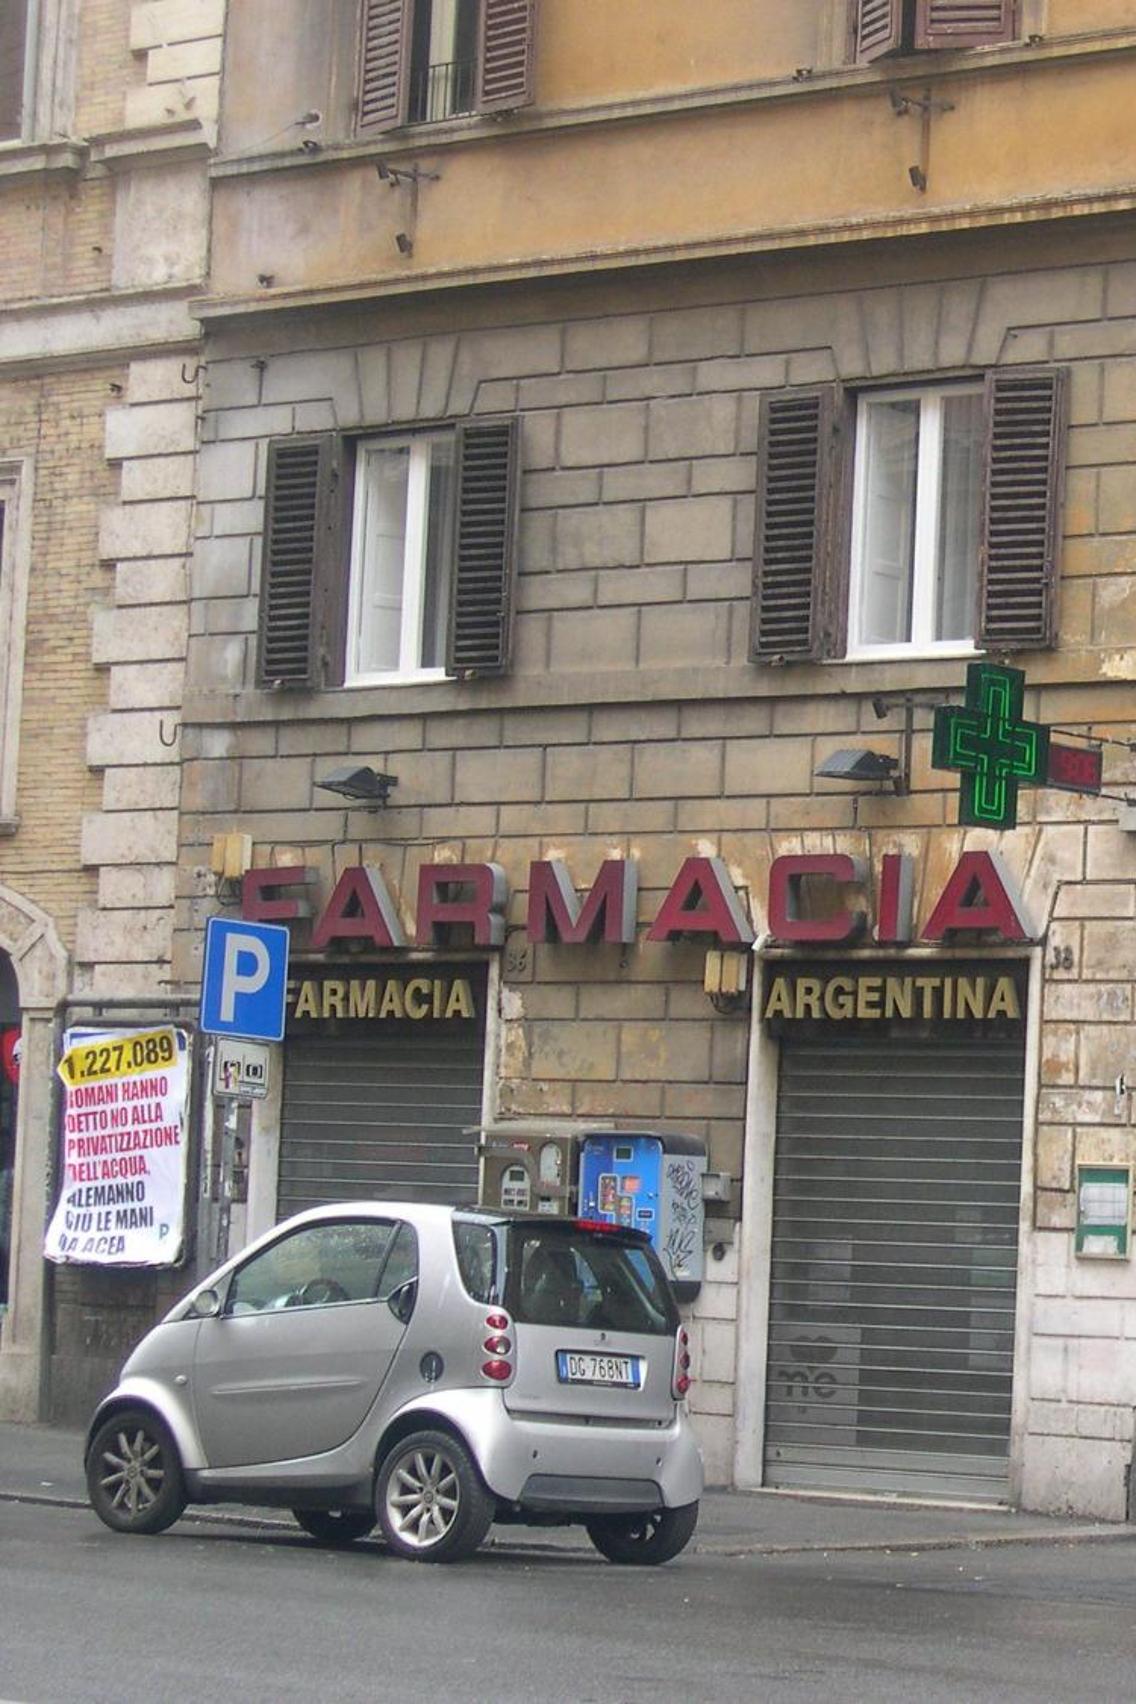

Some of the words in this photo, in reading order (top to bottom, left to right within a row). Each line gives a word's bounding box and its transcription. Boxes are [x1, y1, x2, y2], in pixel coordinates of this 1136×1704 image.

[241, 851, 1036, 947] FARMACIA
[219, 932, 271, 1023] P
[764, 975, 1021, 1020] ARGENTINA
[64, 1036, 174, 1080] 1.227.089
[121, 1075, 168, 1101] HANNO
[67, 1110, 108, 1134] DETTO
[110, 1107, 129, 1129] NO
[131, 1102, 164, 1127] ALLA
[67, 1124, 180, 1160] PRIVATIZZAZIONE
[66, 1179, 146, 1209] ALEMANNO
[96, 1208, 113, 1232] LE
[115, 1206, 154, 1231] MANI
[81, 1235, 126, 1256] ACEA
[569, 1356, 586, 1377] DG
